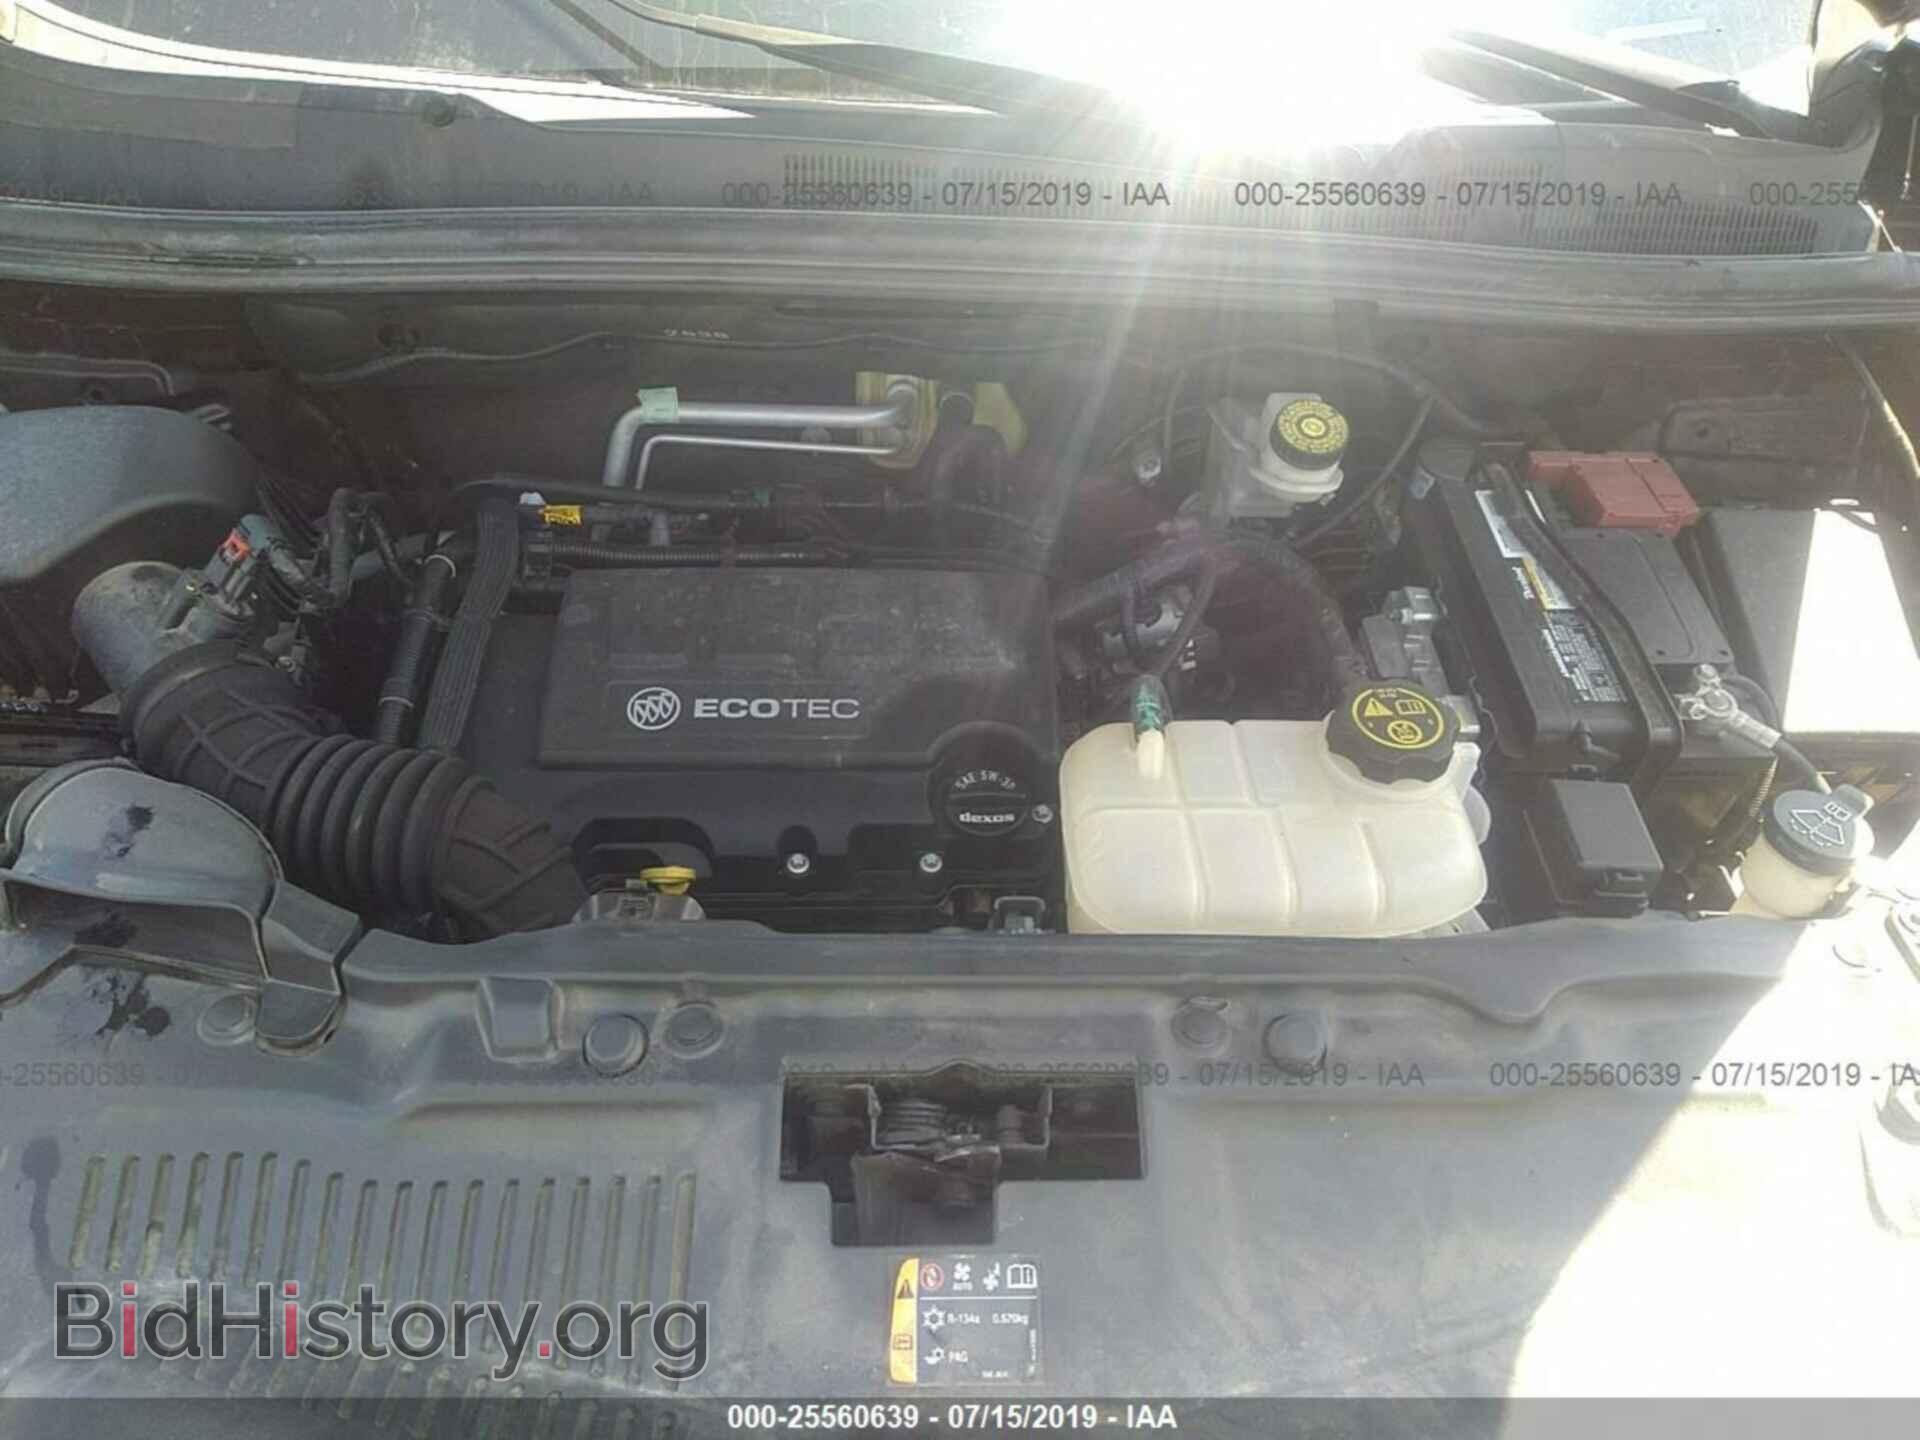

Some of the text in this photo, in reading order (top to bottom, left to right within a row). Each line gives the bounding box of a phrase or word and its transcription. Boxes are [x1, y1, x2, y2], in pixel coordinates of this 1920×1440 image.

[694, 698, 861, 719] ECOTEC
[954, 772, 977, 790] SAE
[959, 811, 1015, 823] dexos
[947, 1312, 981, 1324] R-134a
